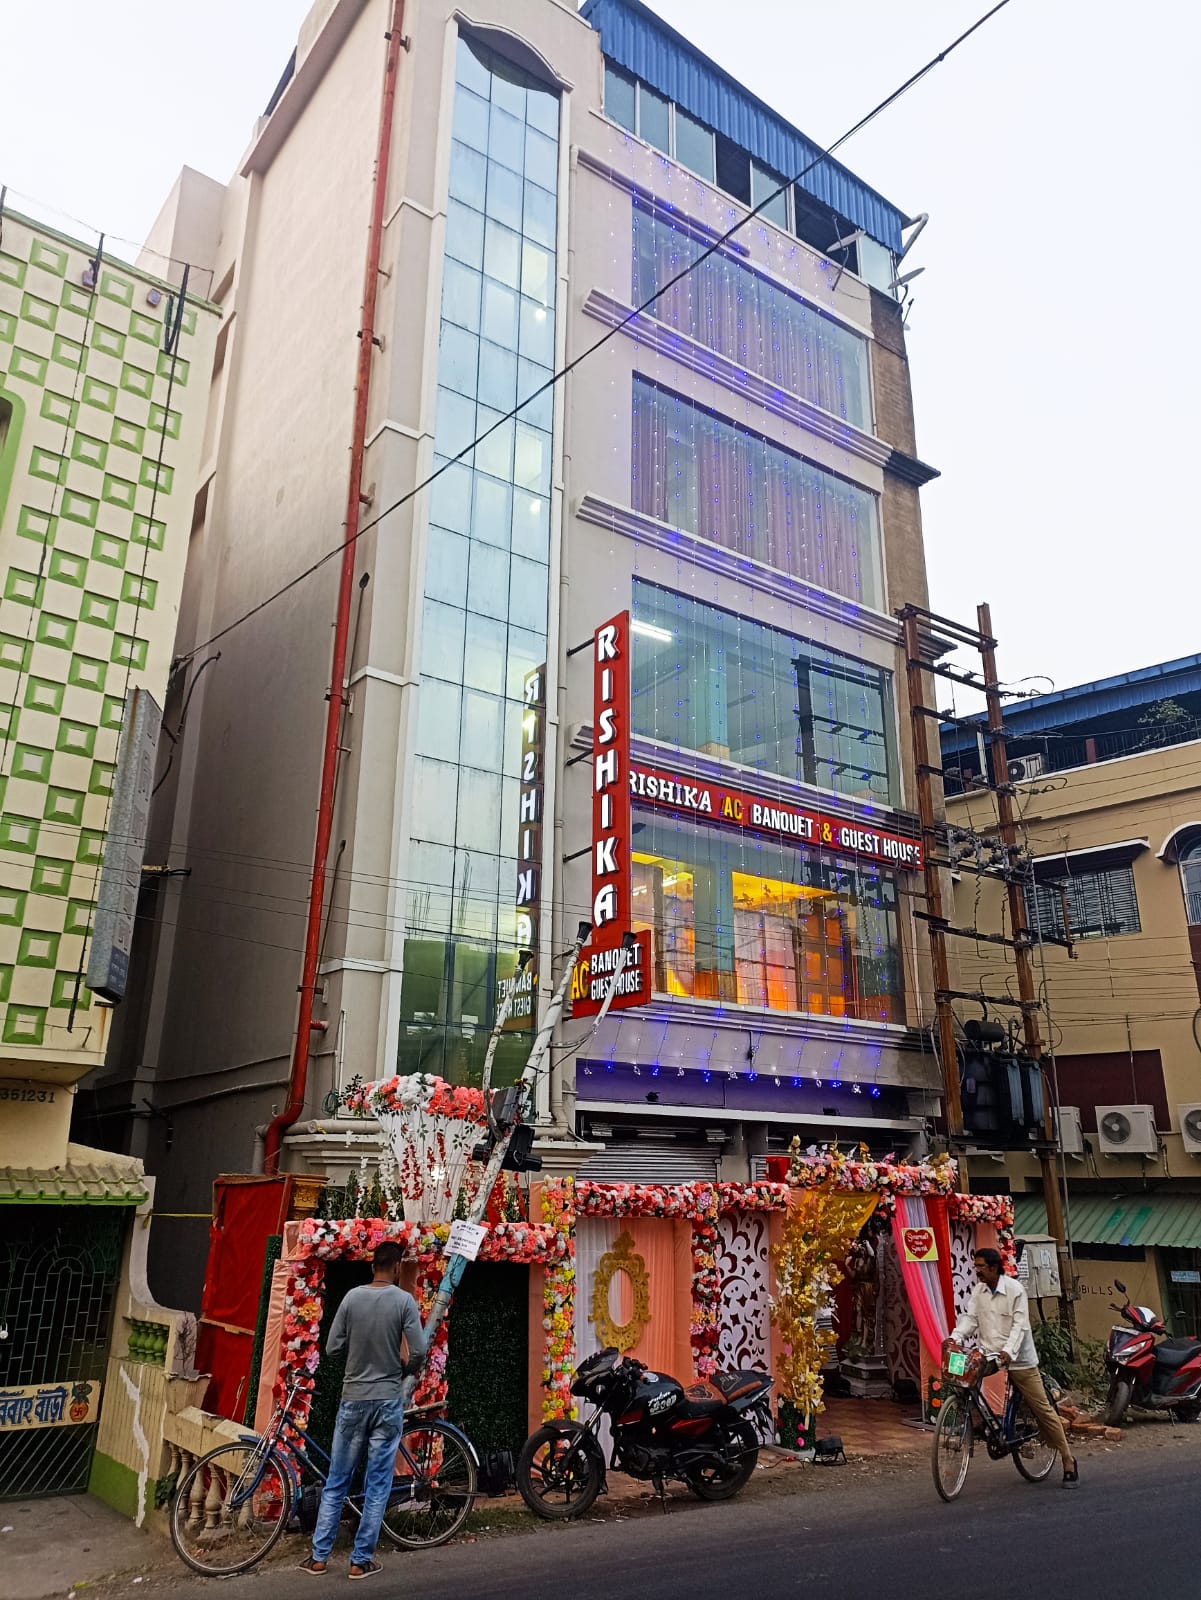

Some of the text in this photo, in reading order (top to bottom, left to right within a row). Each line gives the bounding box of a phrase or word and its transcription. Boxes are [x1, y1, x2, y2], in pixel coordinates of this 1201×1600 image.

[594, 625, 618, 928] RISHIKA
[629, 770, 921, 866] RISHIKA AC BANQUET & GUEST HOUSE
[571, 960, 590, 1000] AC
